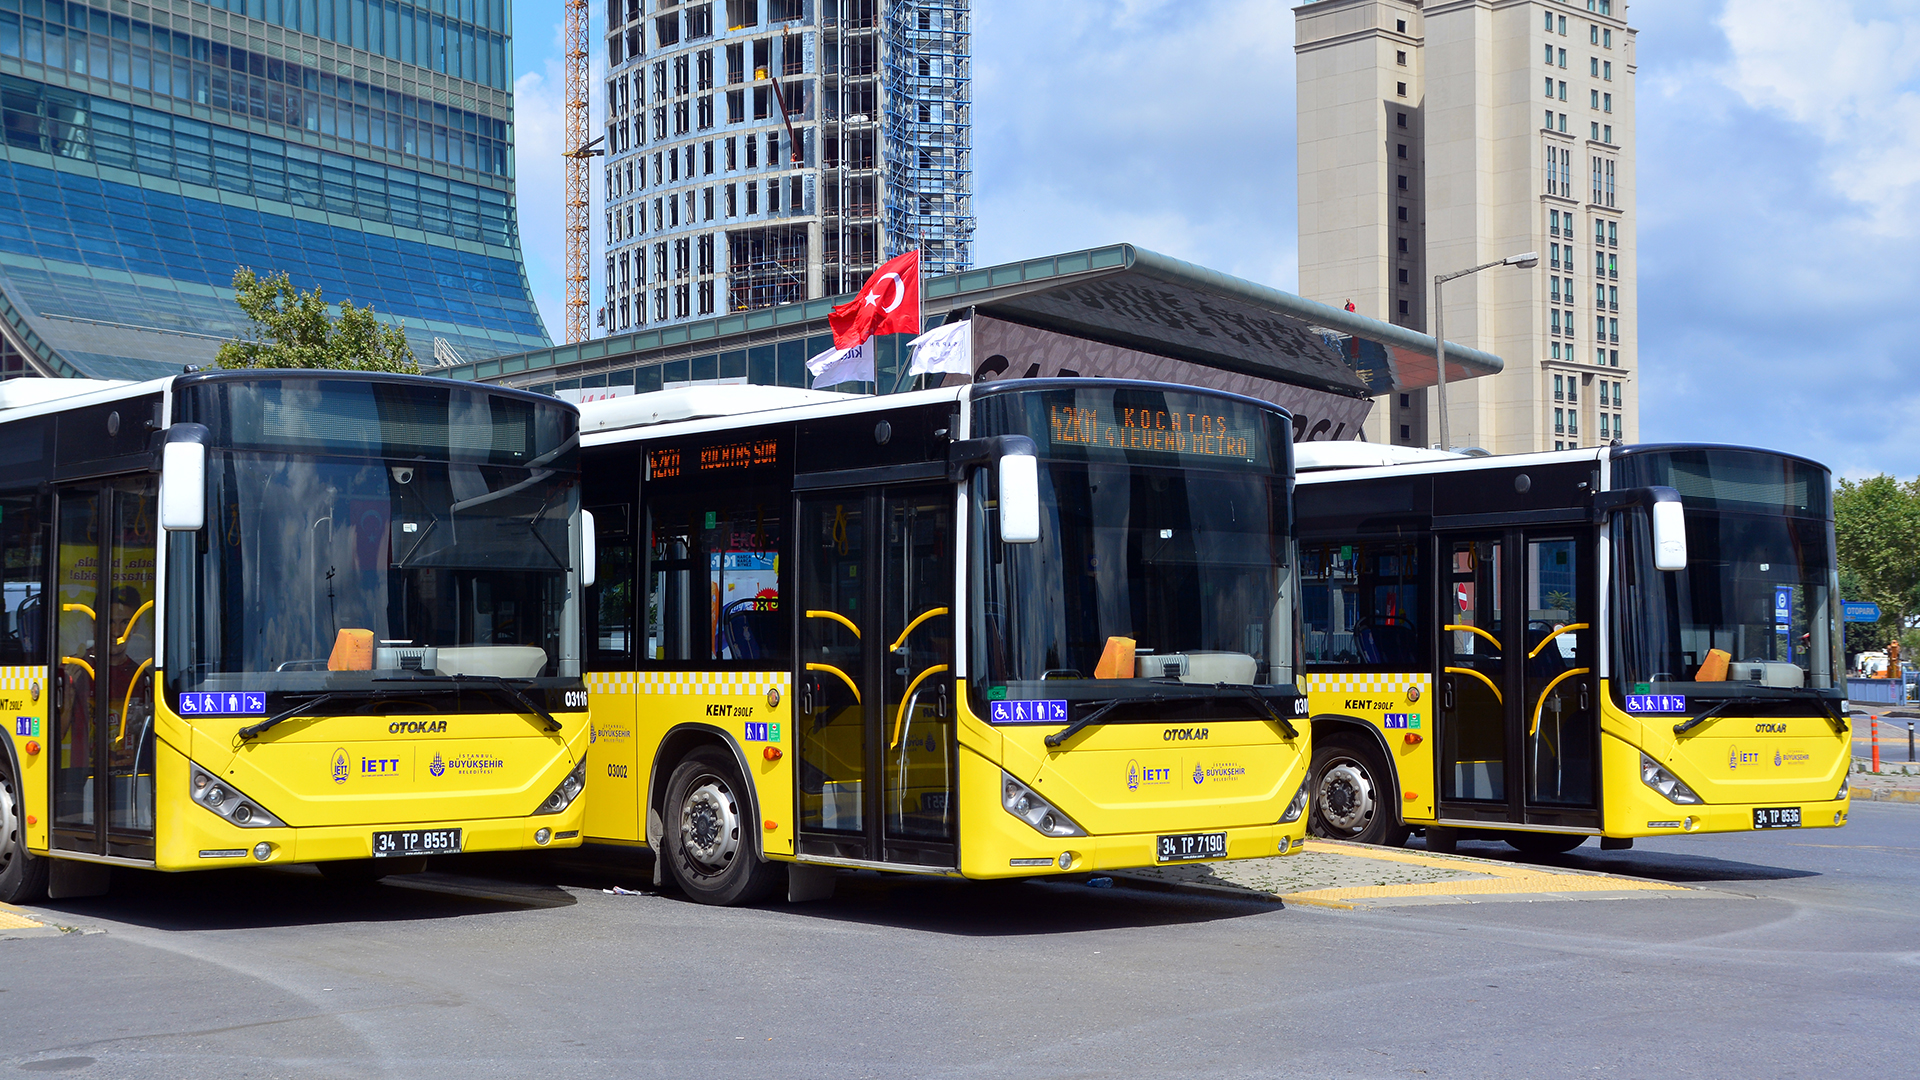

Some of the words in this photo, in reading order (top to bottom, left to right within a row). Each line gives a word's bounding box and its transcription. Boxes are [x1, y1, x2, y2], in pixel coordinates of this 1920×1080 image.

[1051, 405, 1098, 443] 42KM
[1192, 433, 1247, 456] METRO
[1846, 606, 1876, 615] OTOPARK
[706, 704, 733, 716] KENT
[733, 706, 754, 717] 290LF
[1344, 699, 1373, 709] KENT
[1373, 701, 1394, 710] 290LF
[388, 720, 448, 734] OTOKAR
[1163, 727, 1209, 741] OTOKAR
[1755, 722, 1787, 733] OTOKAR
[448, 757, 504, 770] BÜYÜKŞEHİR
[1739, 750, 1759, 763] İETT
[361, 757, 399, 773] İETT
[607, 763, 628, 778] 03002
[1142, 766, 1170, 781] İETT
[1756, 809, 1767, 824] 34
[1769, 809, 1780, 823] TP
[378, 834, 396, 851] 34
[402, 832, 419, 850] TP
[423, 831, 455, 849] 8551
[1162, 837, 1176, 855] 34
[1181, 836, 1194, 854] TP
[1197, 834, 1223, 852] 7190
